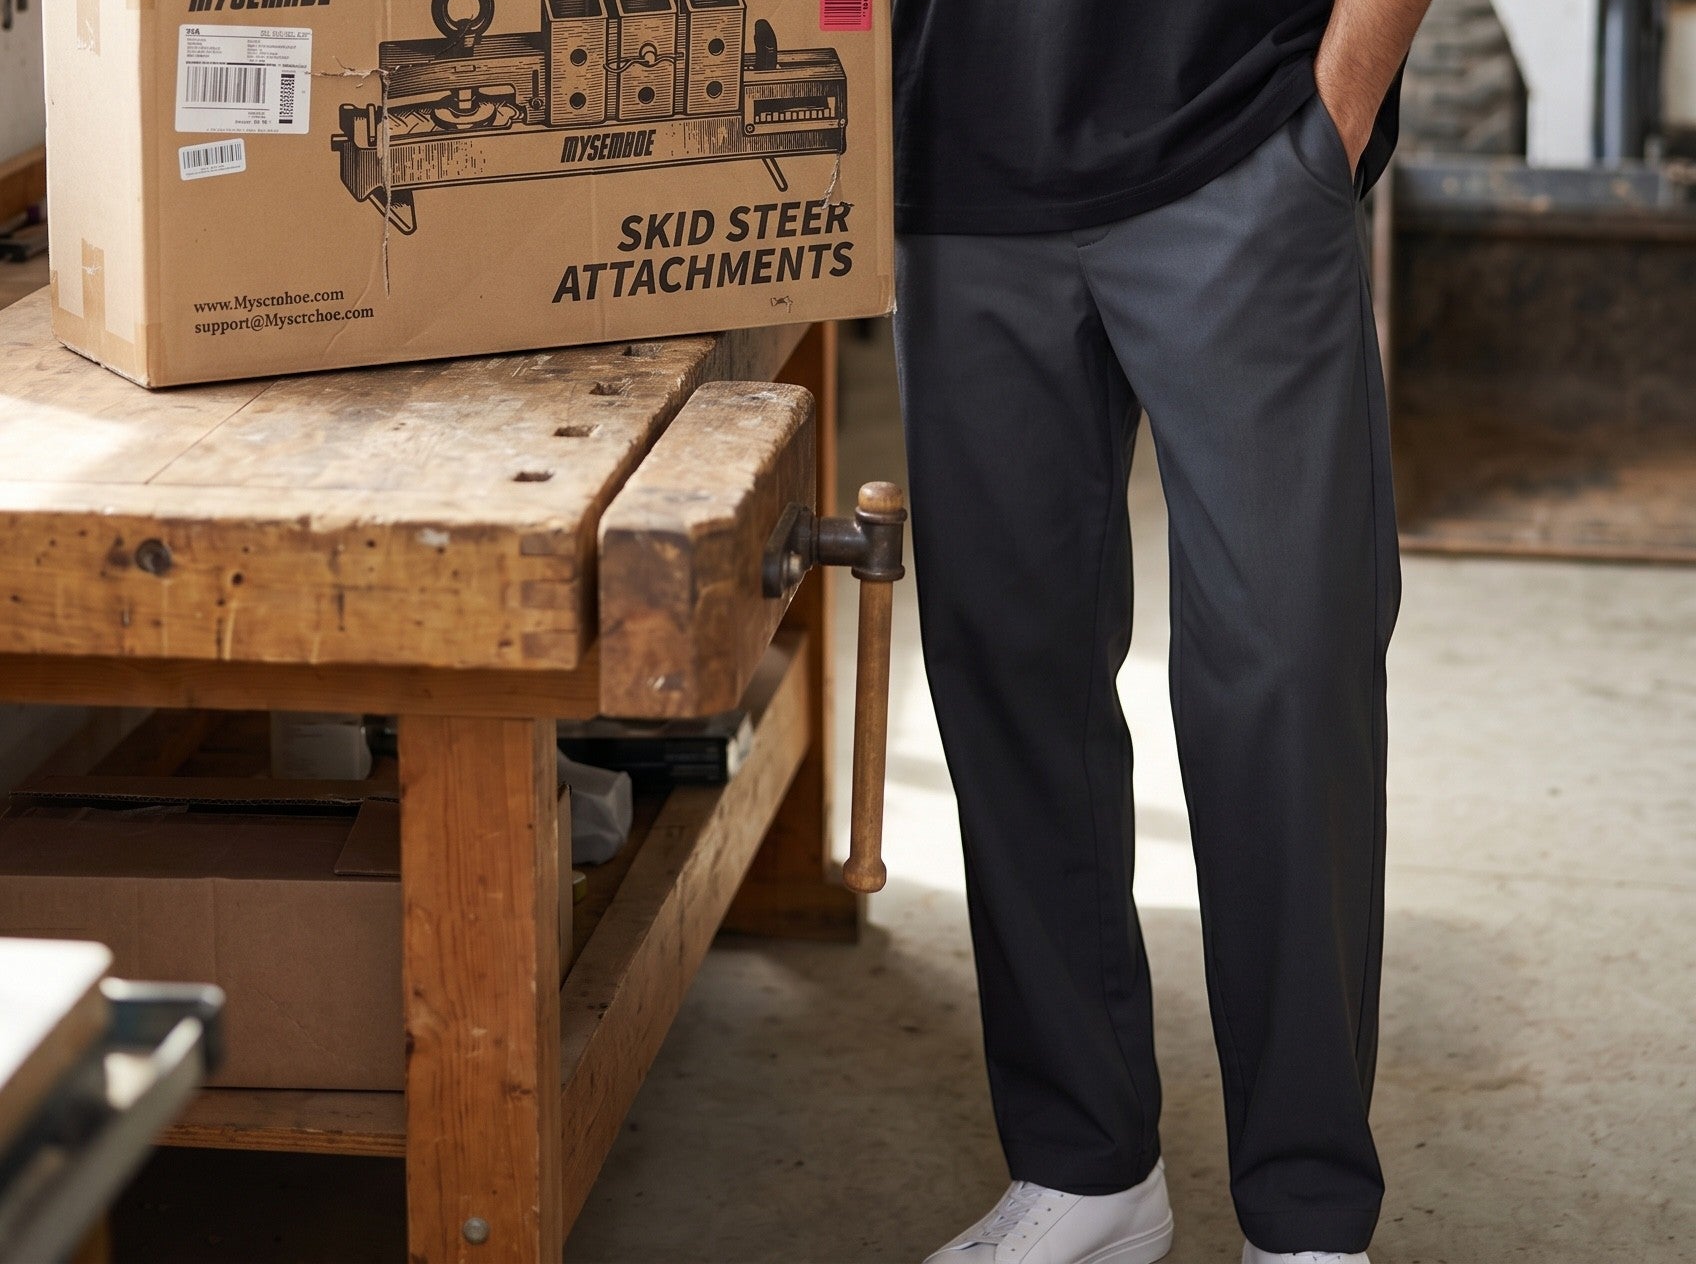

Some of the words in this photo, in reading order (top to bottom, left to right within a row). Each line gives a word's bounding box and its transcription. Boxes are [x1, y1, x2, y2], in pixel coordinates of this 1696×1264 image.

[617, 210, 715, 252] SKID
[726, 198, 851, 243] STEER
[552, 241, 854, 303] ATTACHMENTS
